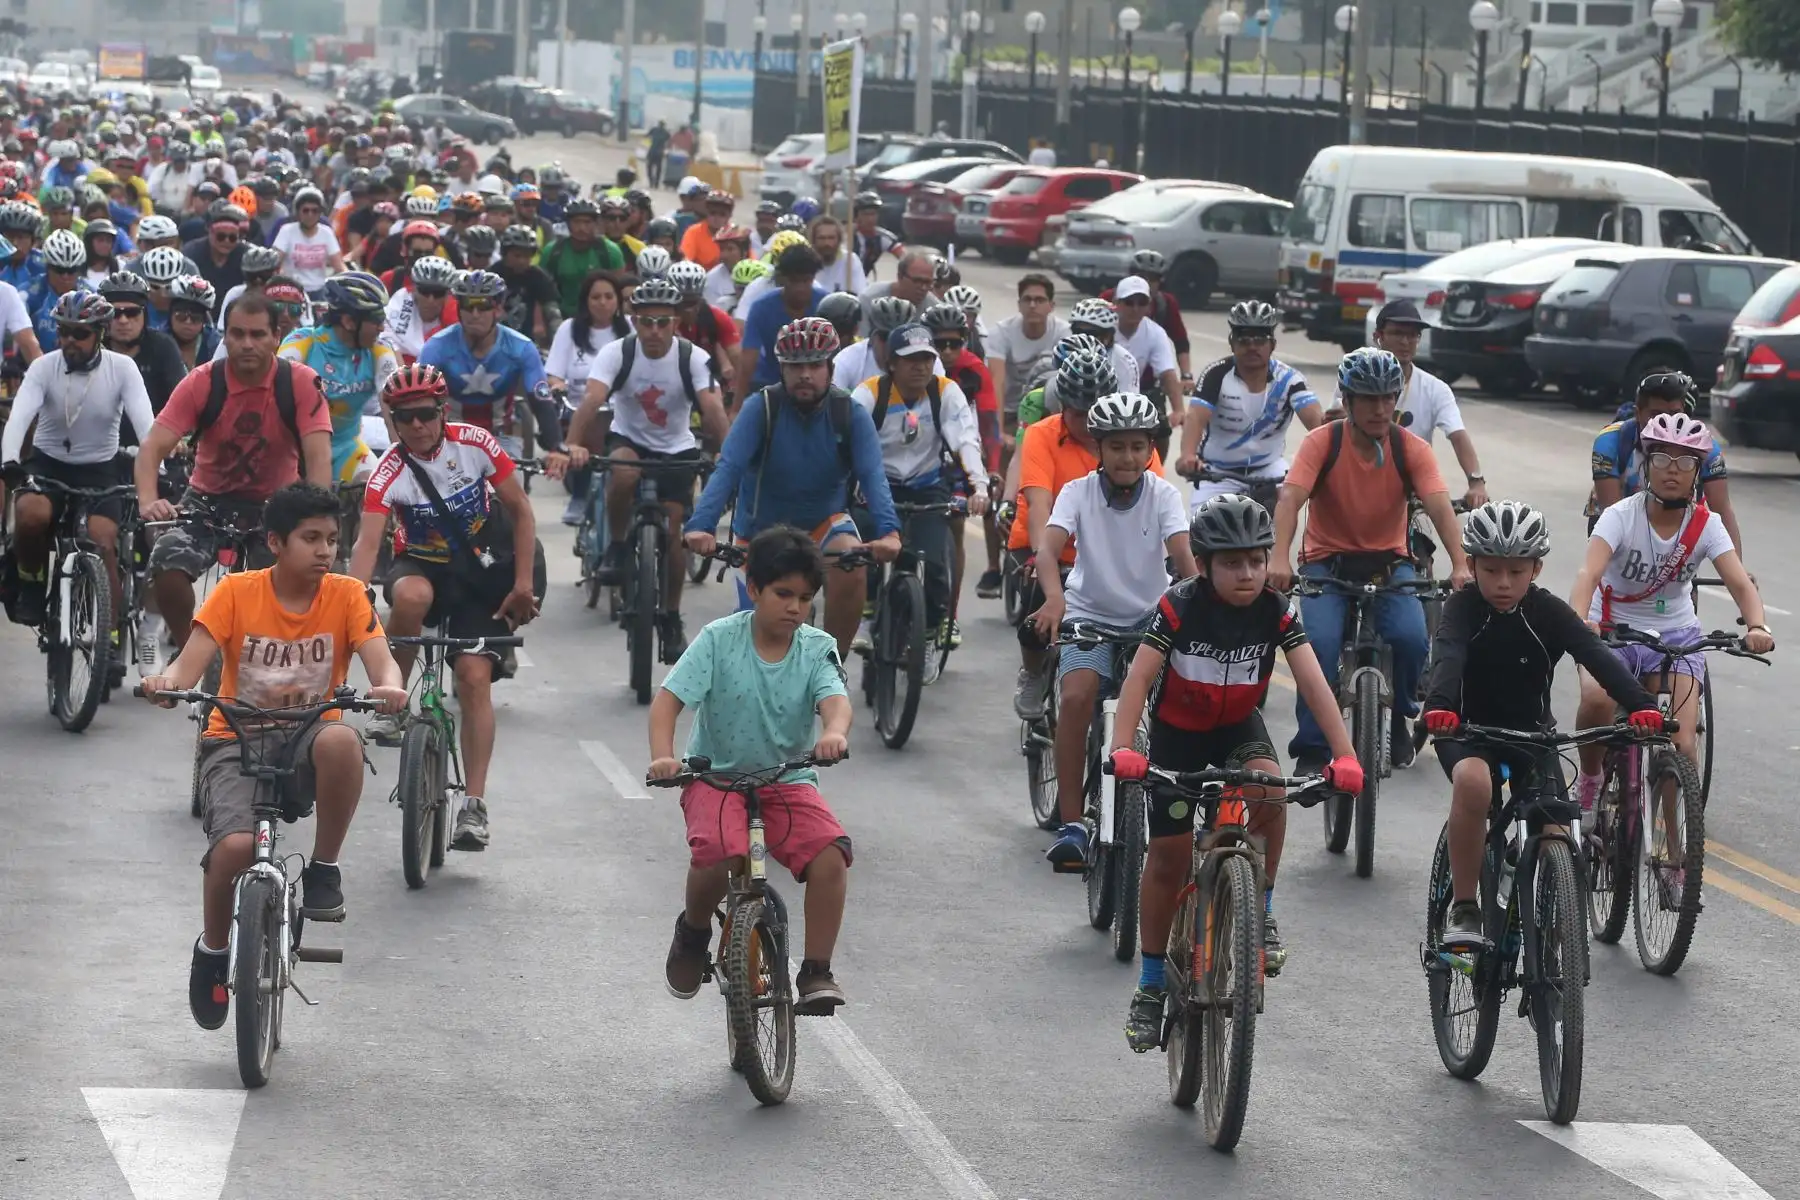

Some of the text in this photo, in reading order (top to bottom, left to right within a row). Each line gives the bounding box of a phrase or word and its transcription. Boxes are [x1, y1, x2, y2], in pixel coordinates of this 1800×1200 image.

[458, 427, 501, 458] AMISTAD
[1621, 549, 1696, 584] BEAES
[248, 637, 325, 668] TOKYO
